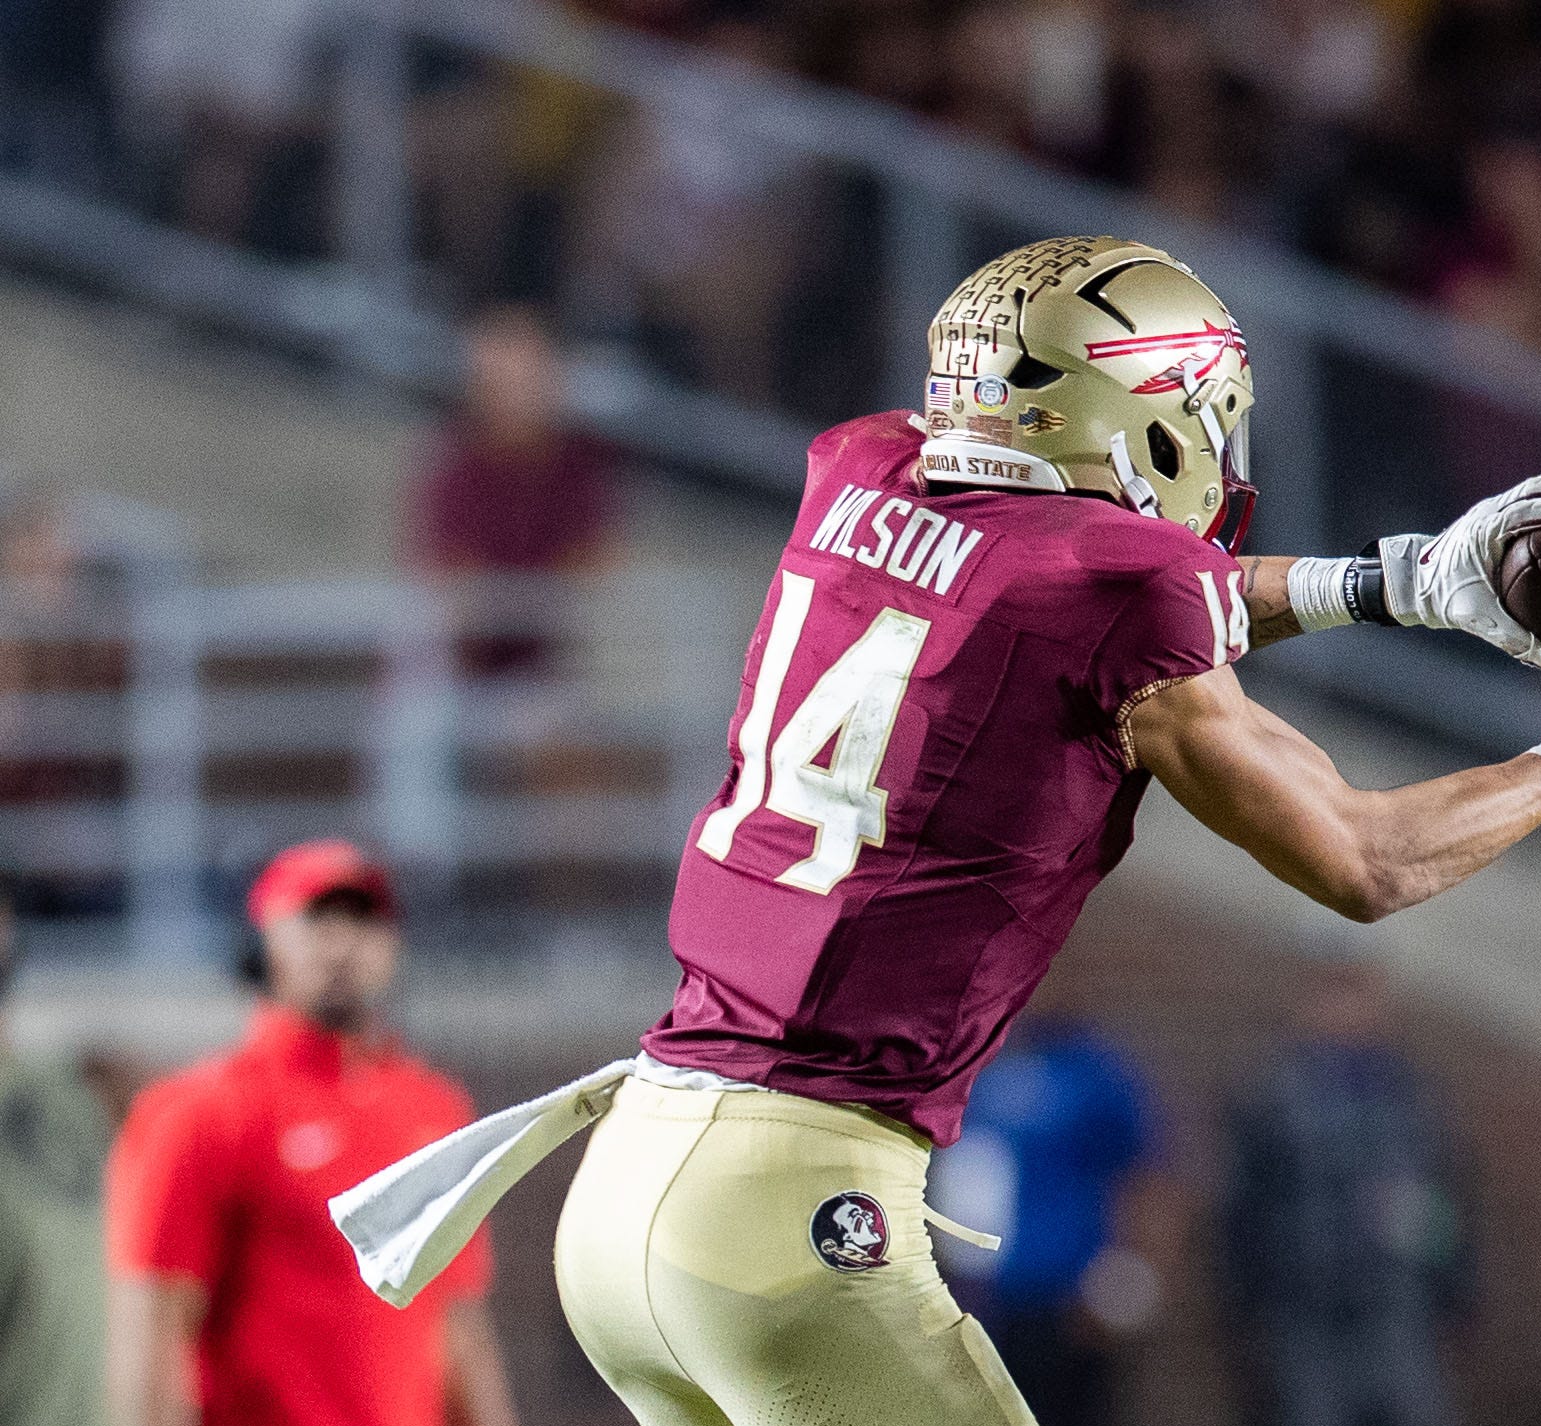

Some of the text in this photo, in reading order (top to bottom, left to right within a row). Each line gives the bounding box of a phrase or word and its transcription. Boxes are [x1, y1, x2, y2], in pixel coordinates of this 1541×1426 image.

[966, 456, 1032, 481] STATE
[809, 484, 984, 596] WILSON
[1194, 570, 1250, 669] 14
[696, 569, 932, 895] 14
